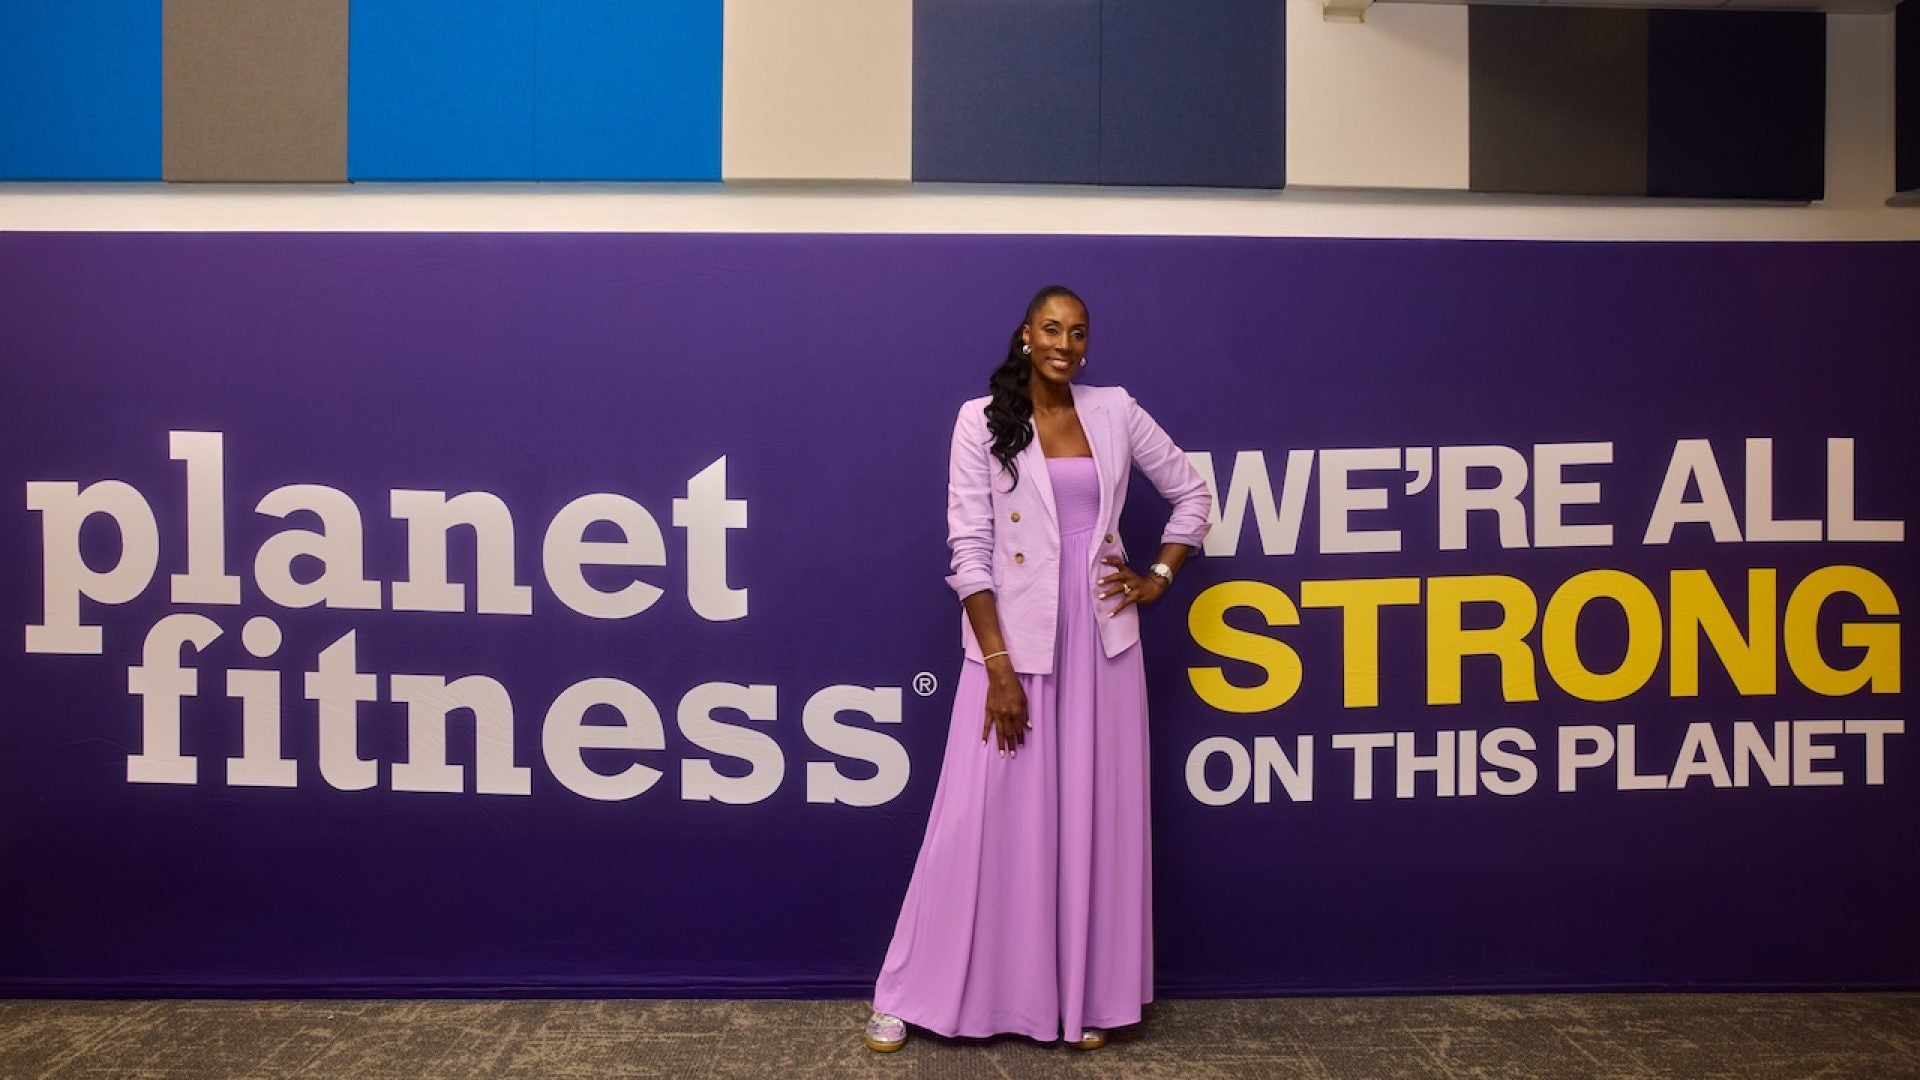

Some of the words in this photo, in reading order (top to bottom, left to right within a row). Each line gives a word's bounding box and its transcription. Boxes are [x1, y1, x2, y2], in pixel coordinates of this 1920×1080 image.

[25, 430, 748, 655] planet
[1184, 441, 1615, 557] WE'RE
[1643, 437, 1904, 545] ALL
[1187, 565, 1902, 713] STRONG
[1185, 735, 1314, 806] ON
[1331, 727, 1538, 800] THIS
[1558, 719, 1905, 793] PLANET
